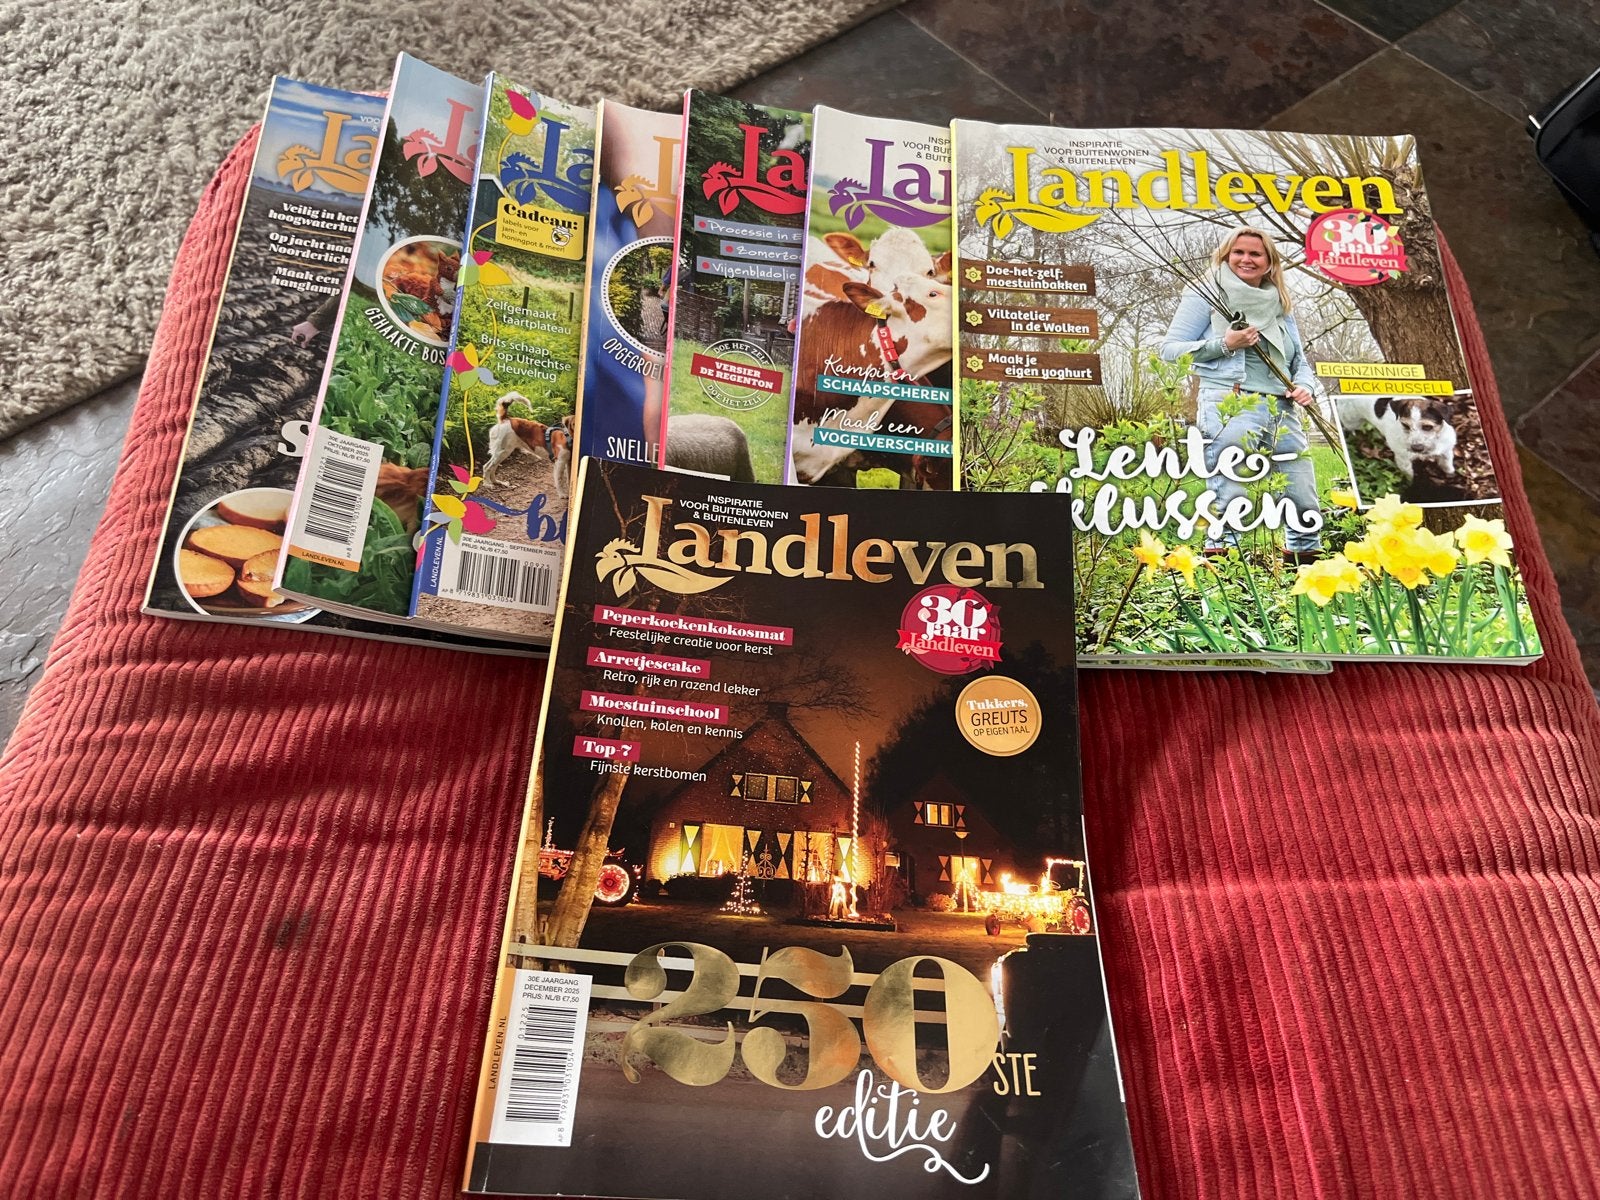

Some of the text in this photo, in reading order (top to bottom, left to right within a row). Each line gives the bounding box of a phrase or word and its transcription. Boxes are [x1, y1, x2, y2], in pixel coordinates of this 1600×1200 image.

[903, 141, 930, 151] VOOR
[916, 151, 922, 159] &
[1044, 146, 1072, 155] VOOR
[1068, 157, 1136, 165] BUITENLEVEN
[1003, 146, 1403, 216] Landleven
[268, 209, 357, 233] hoogwaterhu
[283, 203, 359, 223] Veilig in het
[503, 203, 578, 230] Cadeau:
[503, 218, 522, 229] labels
[707, 219, 773, 239] Processie
[777, 230, 788, 240] in
[269, 232, 352, 253] Op jacht naa
[502, 233, 537, 248] honingpot
[268, 244, 349, 264] Noorderlich
[1318, 251, 1399, 268] Landleven
[275, 267, 340, 285] Maak een
[712, 263, 797, 280] Vijgenbladolie
[986, 265, 1064, 280] Doe-het-zelf:
[271, 275, 341, 297] hanglamp
[986, 277, 1087, 291] moestuinbakken
[486, 298, 557, 321] Zelfgemaakt
[987, 308, 1051, 321] Viltatelier
[503, 314, 571, 335] taartplateau
[1011, 322, 1090, 334] In de Wolken
[364, 307, 419, 356] GEHAAKTE
[421, 346, 446, 365] BOS
[481, 333, 550, 357] Brits schaap
[497, 352, 571, 371] op Utrechtse
[713, 342, 769, 366] DOE HET ZELF
[988, 353, 1037, 366] Maak je
[497, 362, 557, 382] Heuvelrug
[699, 367, 774, 389] DE REGENTON
[714, 361, 761, 378] VERSIER
[823, 354, 918, 386] Kampioen
[1005, 366, 1092, 380] eigen yoghurt
[1321, 364, 1419, 377] EIGENZINNIGE
[707, 384, 763, 407] DOE HET ZELF
[823, 378, 950, 401] SCHAAPSCHEREN
[1345, 382, 1449, 394] JACK RUSSELL
[820, 407, 925, 435] Maak een
[328, 441, 355, 453] OKTOBER
[340, 438, 371, 451] JAARGANG
[606, 436, 660, 463] SNELLE
[819, 431, 953, 455] VOGELVERSCHRIK
[1059, 426, 1299, 483] Lente-
[680, 499, 789, 520] VOOR BUITENWONEN
[707, 495, 763, 508] INSPIRATIE
[693, 511, 774, 528] & BUITENLEVEN
[473, 538, 504, 548] JAARGANG
[509, 544, 543, 555] SEPTEMBER
[638, 494, 1044, 589] Landleven
[302, 551, 346, 567] LANDLEVEN.NL
[430, 536, 443, 588] LANDLEVEN.NL
[917, 594, 988, 628] 30
[602, 609, 786, 642] Peperkoekenkokosmat
[921, 622, 987, 641] jaar
[609, 627, 774, 656] Feestelijke creatie voor kerst
[909, 632, 995, 658] Landleven
[594, 651, 702, 674] Arretjescake
[603, 670, 761, 696] Retro, rijk en razend lekker
[588, 694, 721, 720] Moestuinschool
[966, 698, 1028, 711] Tukkers,
[597, 714, 743, 739] Knollen, kolen en kennis
[971, 709, 1028, 727] GREUTS
[973, 725, 1030, 736] OP EIGEN TAAL
[590, 760, 707, 782] Fijnste kerstbomen
[524, 983, 563, 993] DECEMBER
[528, 975, 579, 986] 30E JAARGANG
[562, 995, 580, 1003] €7,50
[518, 1006, 529, 1040] 01225
[622, 941, 1041, 1096] 250 STE
[488, 1015, 508, 1090] LANDLEVEN.NL
[814, 1068, 990, 1185] editie
